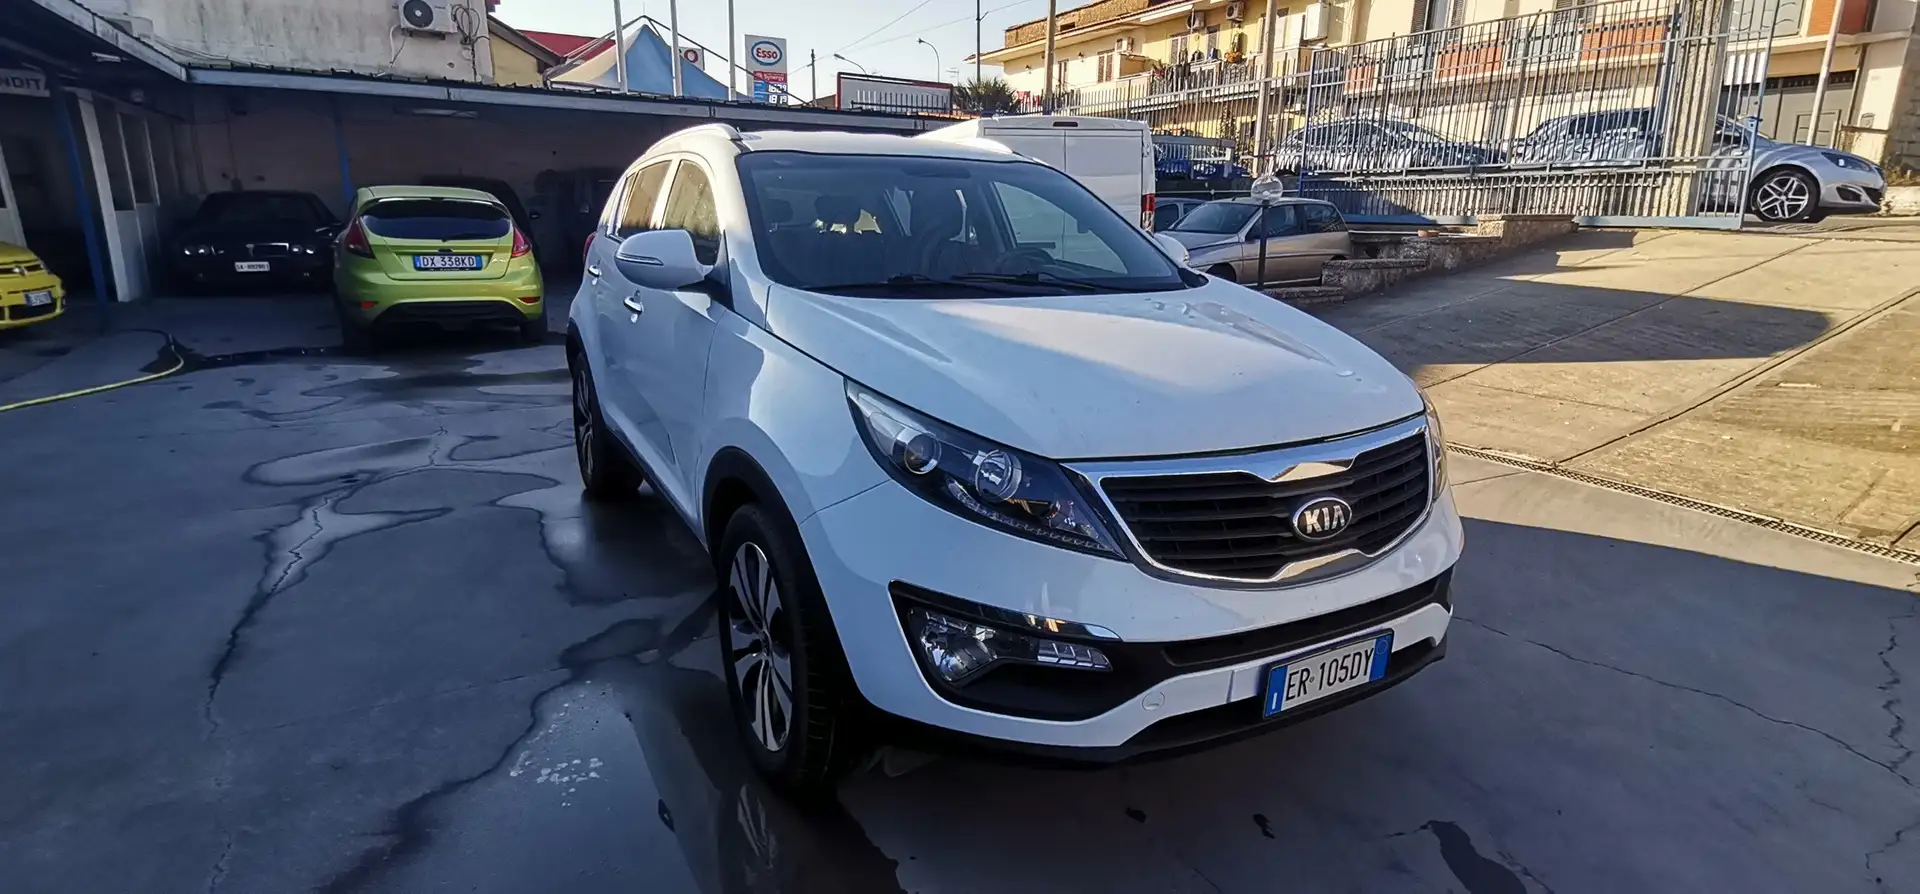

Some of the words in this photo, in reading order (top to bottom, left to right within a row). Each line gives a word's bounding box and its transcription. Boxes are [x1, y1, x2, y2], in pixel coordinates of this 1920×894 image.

[756, 47, 778, 59] Esso
[422, 256, 436, 267] DX
[1304, 504, 1346, 534] KIA
[1286, 668, 1310, 701] ER
[1318, 648, 1374, 690] 105DY
